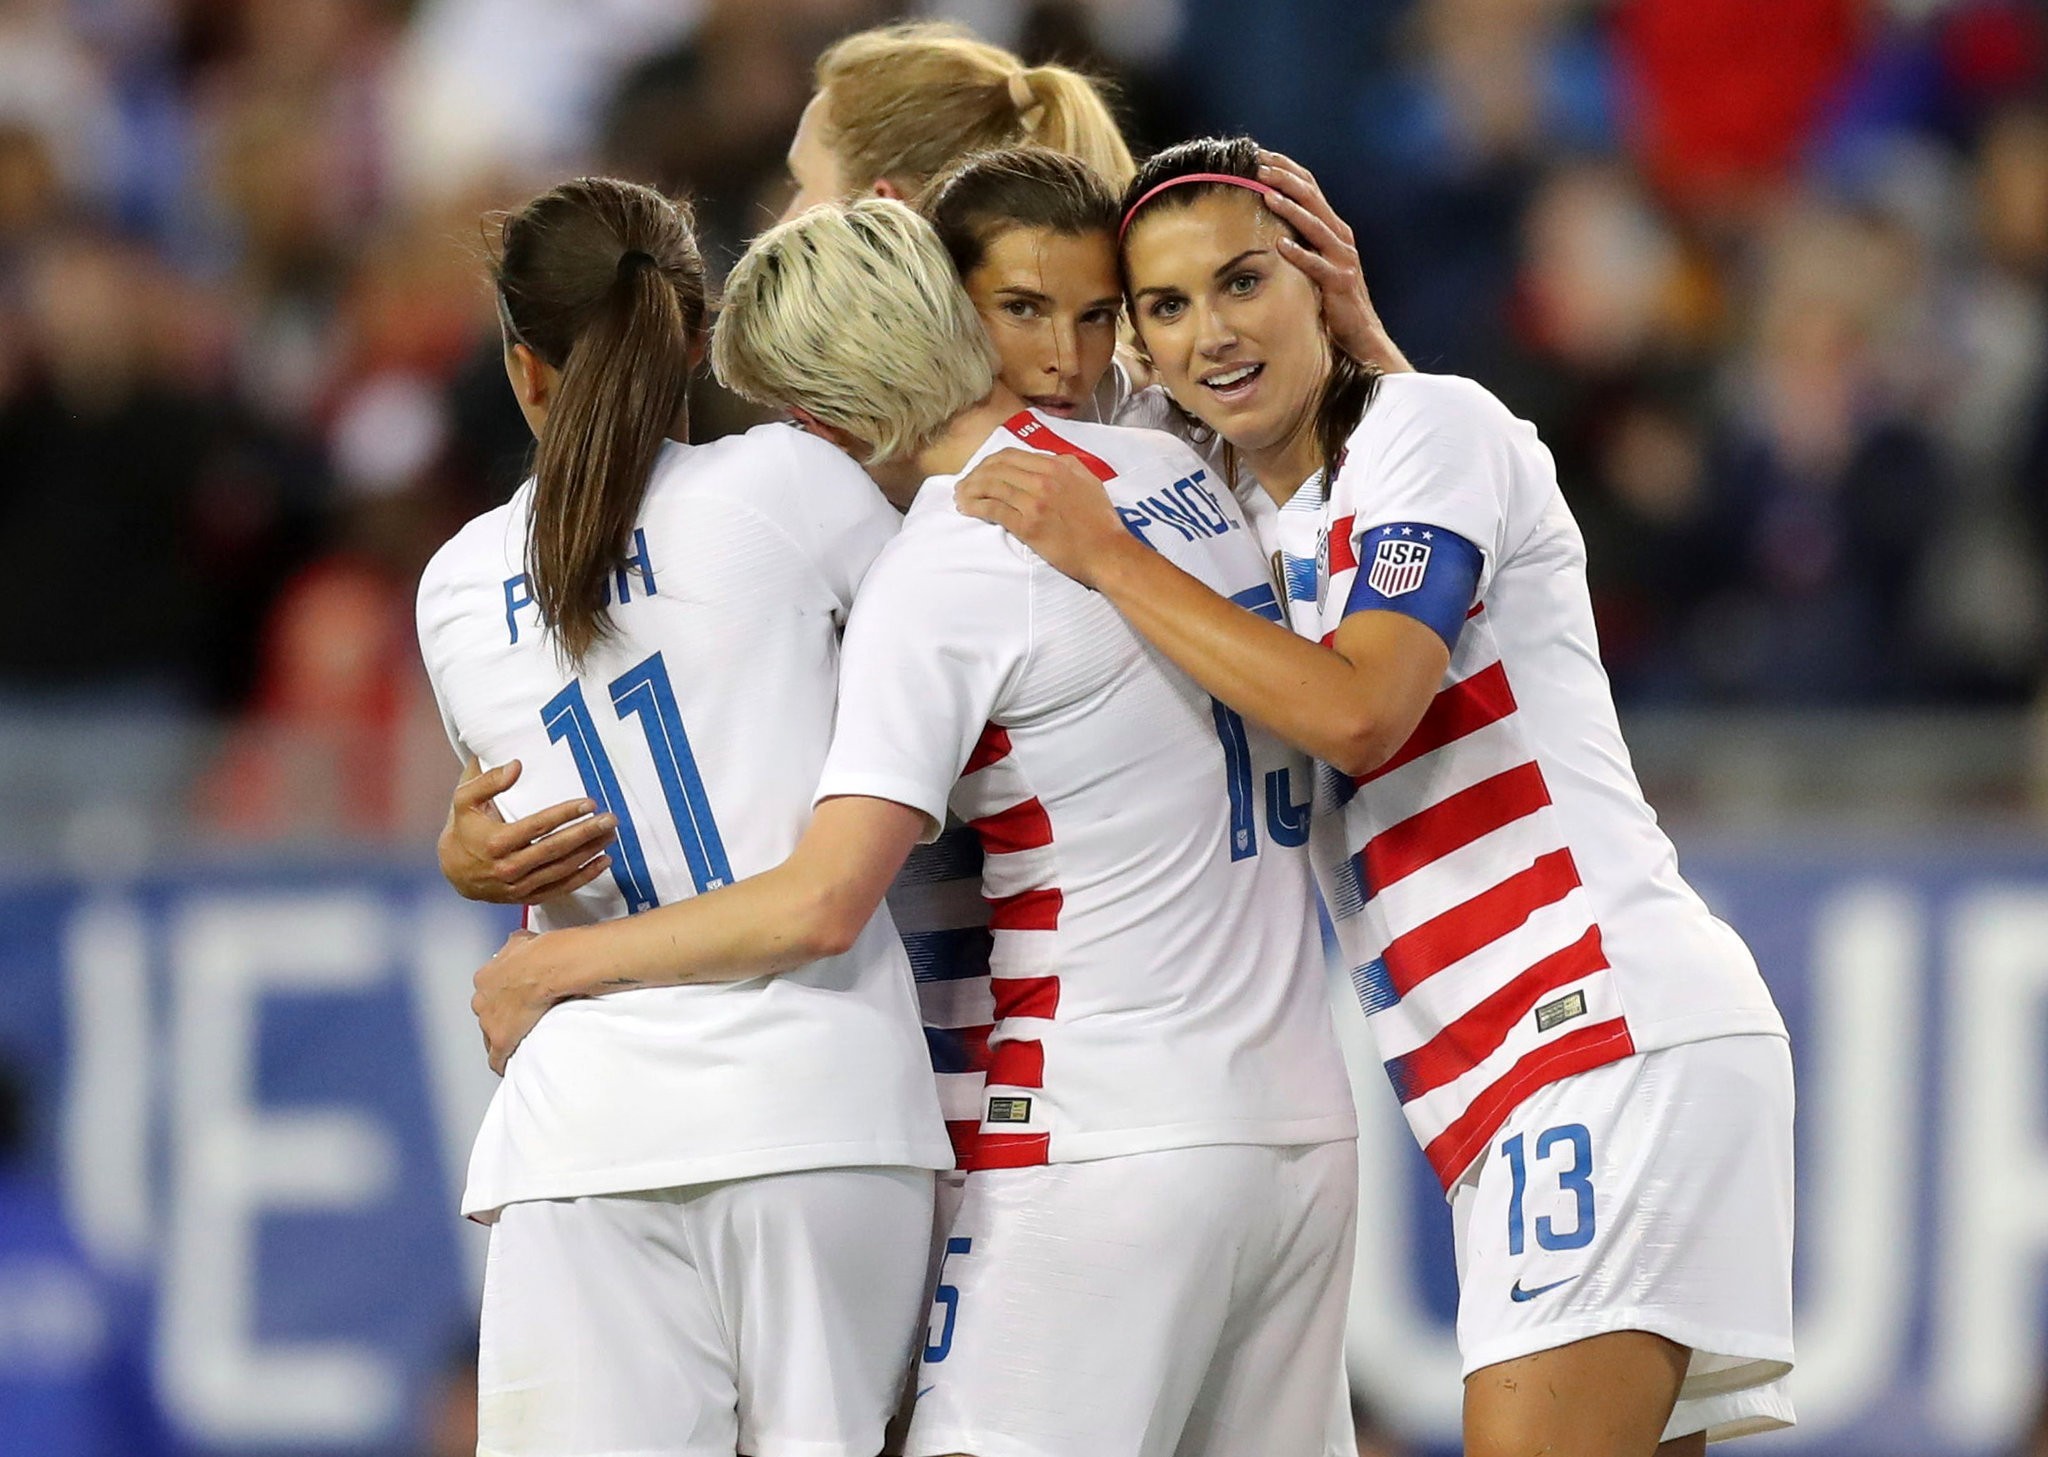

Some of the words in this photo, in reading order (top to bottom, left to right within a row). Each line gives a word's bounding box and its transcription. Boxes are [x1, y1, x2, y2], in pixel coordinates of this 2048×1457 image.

[1016, 421, 1042, 438] USA
[502, 527, 658, 646] PH
[1379, 543, 1427, 565] USA
[540, 650, 736, 916] 11
[1501, 1123, 1597, 1256] 13
